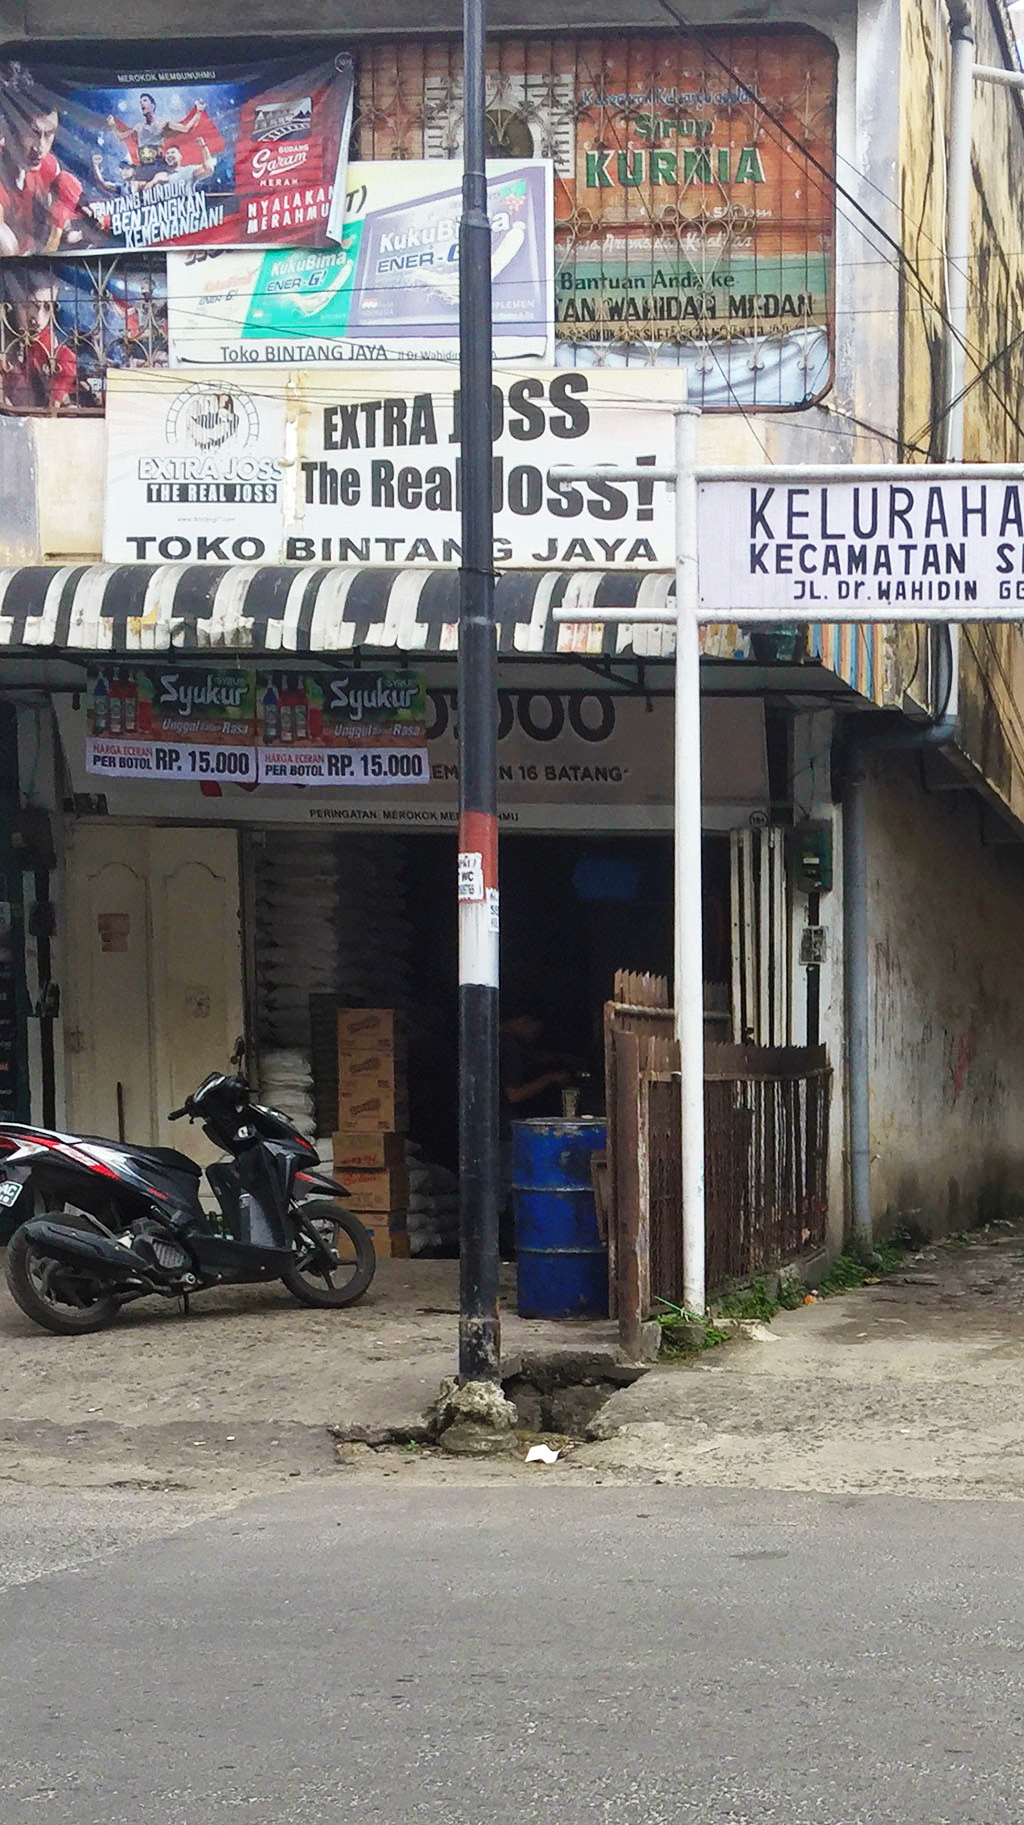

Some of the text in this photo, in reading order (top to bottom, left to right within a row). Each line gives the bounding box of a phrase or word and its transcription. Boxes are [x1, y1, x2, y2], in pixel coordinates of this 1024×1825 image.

[635, 113, 714, 138] Sirup
[252, 149, 308, 178] Garam
[586, 147, 766, 188] KURNIA
[260, 178, 299, 187] MERAH
[112, 191, 208, 235] BENTANGKAN
[247, 202, 331, 234] MERAHMU
[125, 205, 224, 248] KEMENANGAN!
[380, 211, 511, 253] KukuBia
[271, 252, 347, 277] KukuBima
[560, 269, 735, 290] Bantuan Anda ke
[220, 342, 388, 362] Toko BINTANG JAYA
[323, 393, 438, 451] EXTRA
[138, 457, 219, 480] EXTRA
[151, 485, 275, 501] THE REAL JOSS
[301, 461, 361, 506] The
[126, 536, 266, 561] TOKO
[532, 537, 658, 562] JAYA
[750, 543, 966, 575] KECAMATAN
[160, 673, 249, 716] Syukur
[330, 677, 420, 720] Syukur
[93, 755, 152, 770] PER BOTOL
[155, 748, 250, 775] RP. 15.000
[265, 765, 324, 777] PER BOTOL
[327, 754, 355, 777] RP.
[361, 754, 423, 777] 15.000
[520, 765, 538, 781] 16
[309, 808, 377, 819] PERINGATAN
[382, 810, 439, 821] MEROKOK
